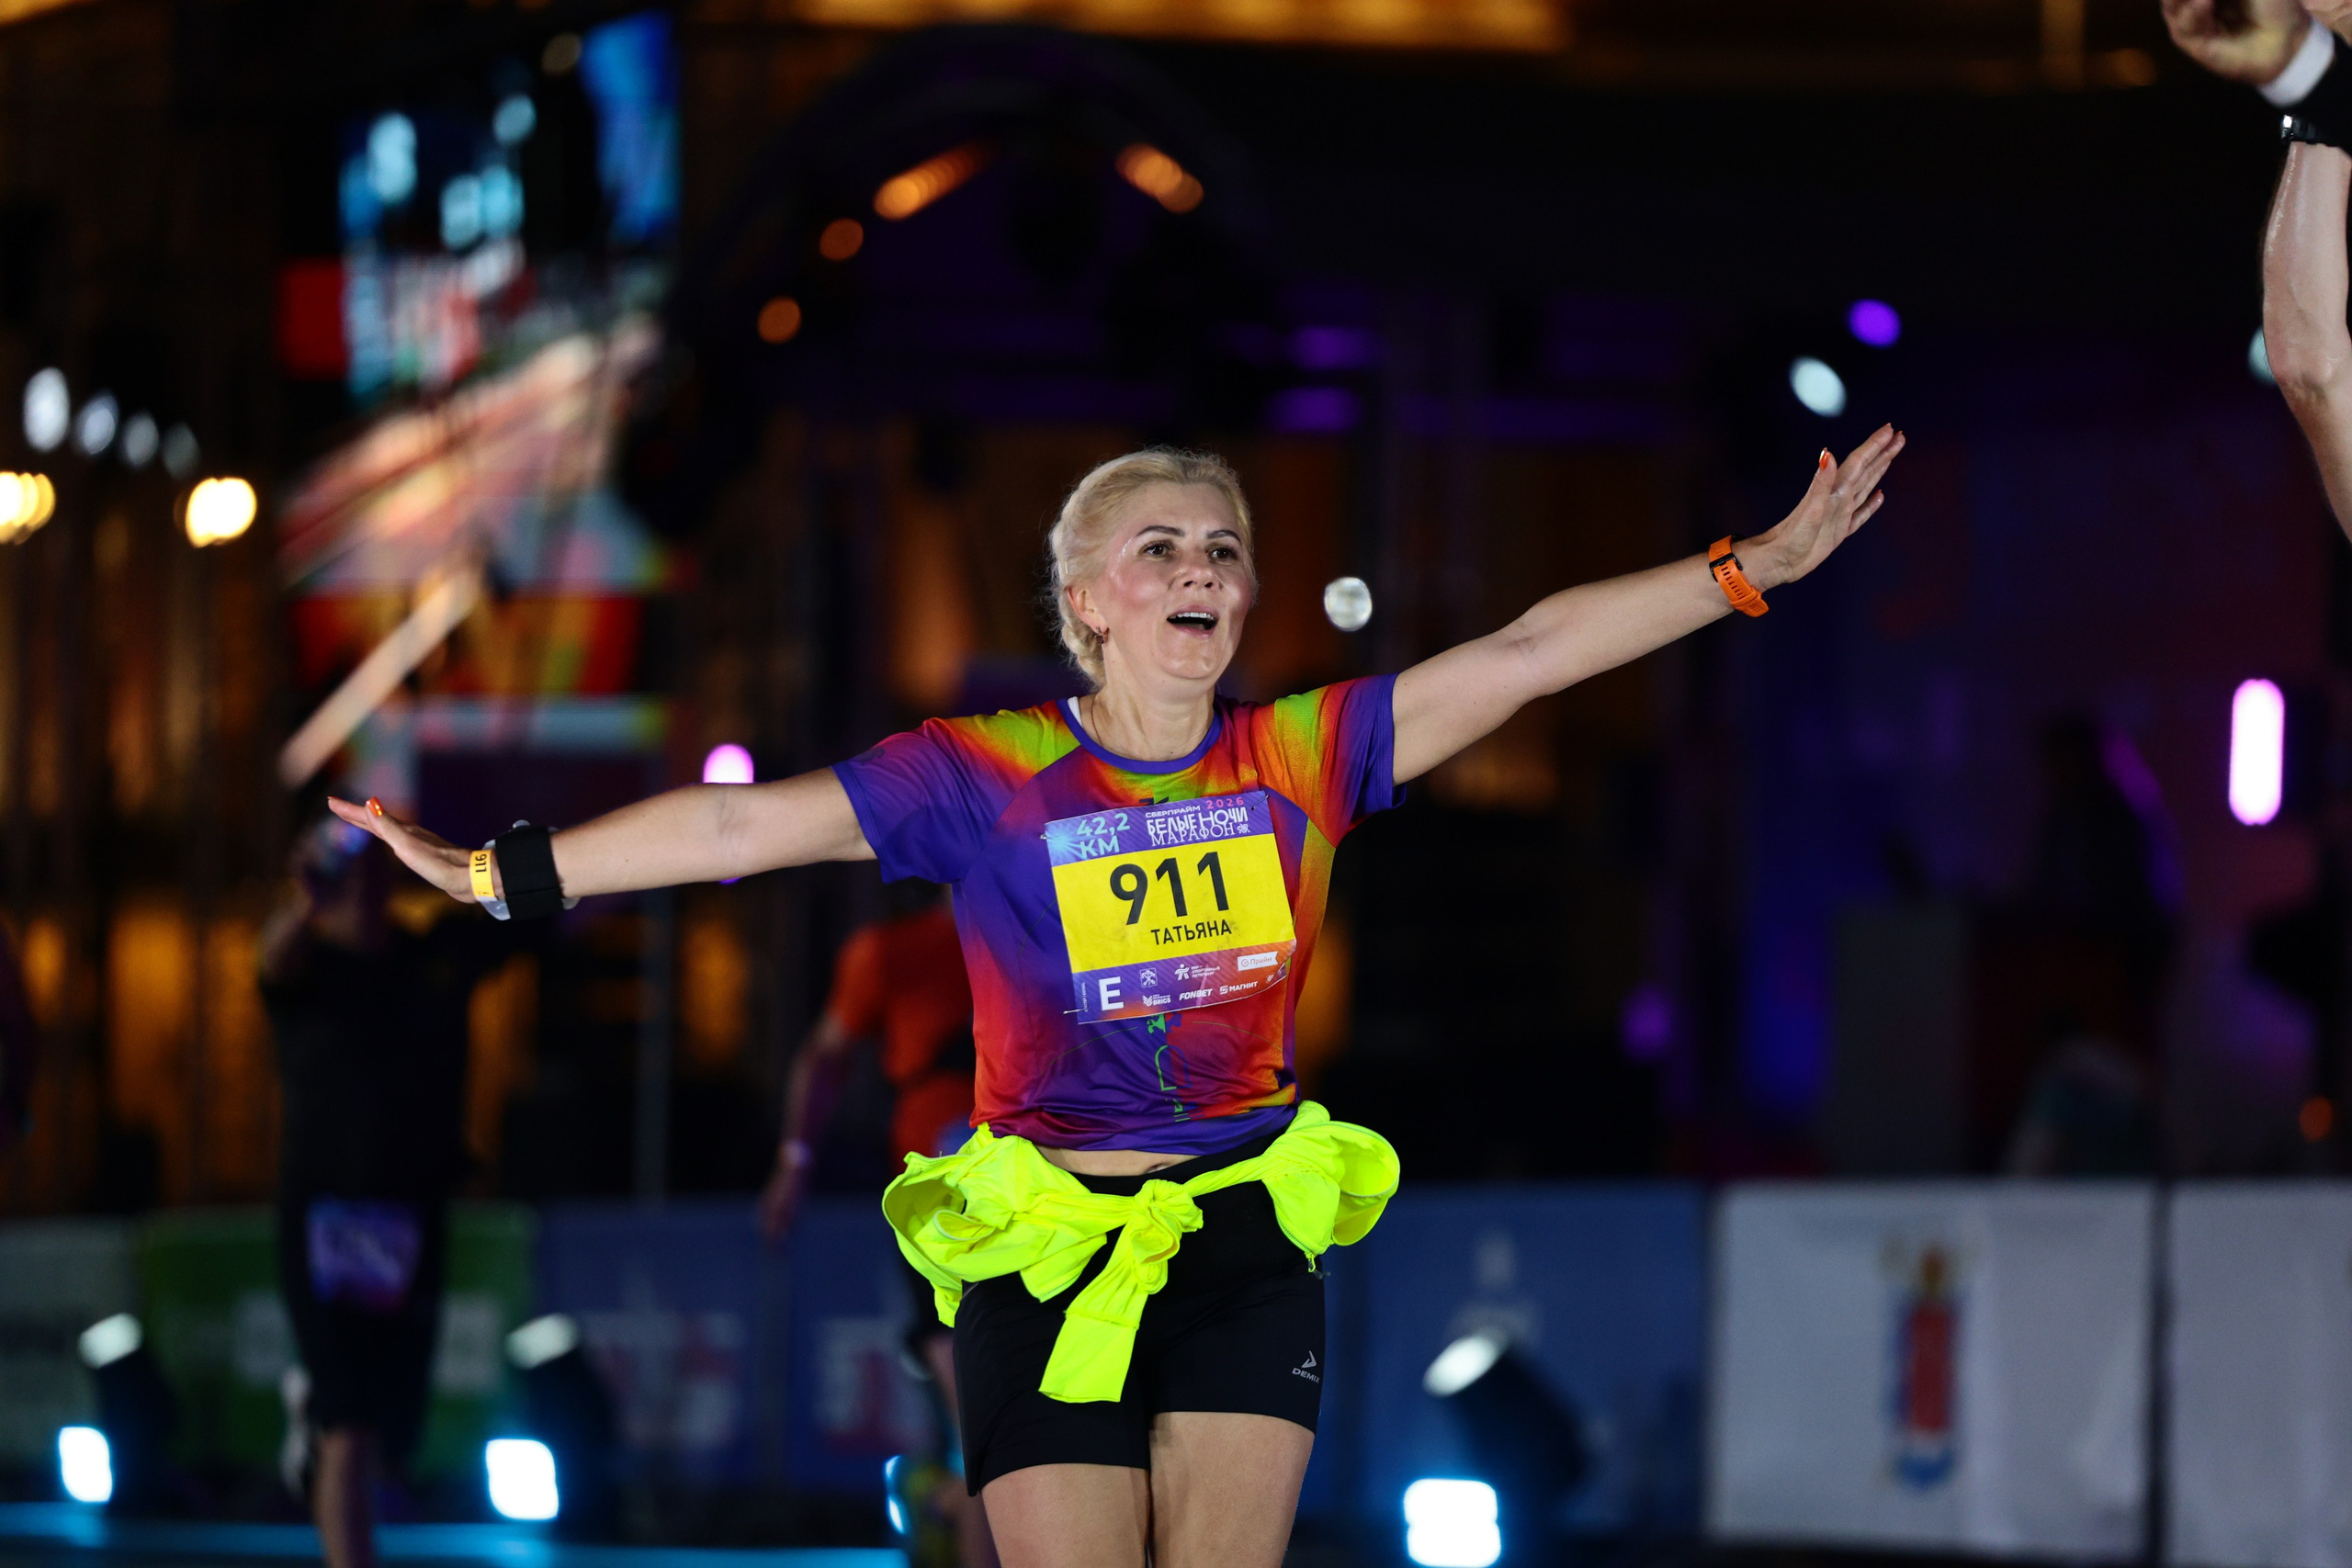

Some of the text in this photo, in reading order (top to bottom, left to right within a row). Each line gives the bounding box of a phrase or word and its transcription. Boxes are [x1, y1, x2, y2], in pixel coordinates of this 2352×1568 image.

[1145, 796, 1244, 818] СБЕРПРАЙМ 2026
[1076, 812, 1131, 838] 42,2
[1147, 807, 1249, 836] БЕЛЫЕ НОЧИ
[1151, 822, 1236, 847] МАРАФОН
[1080, 836, 1120, 858] КМ
[475, 853, 488, 873] 911
[1109, 851, 1229, 926] 911
[1151, 919, 1232, 946] ТАТЬЯНА
[1179, 988, 1213, 1001] FONBET
[1229, 981, 1258, 992] МАГНИТ
[1292, 1367, 1320, 1383] DEMIX
